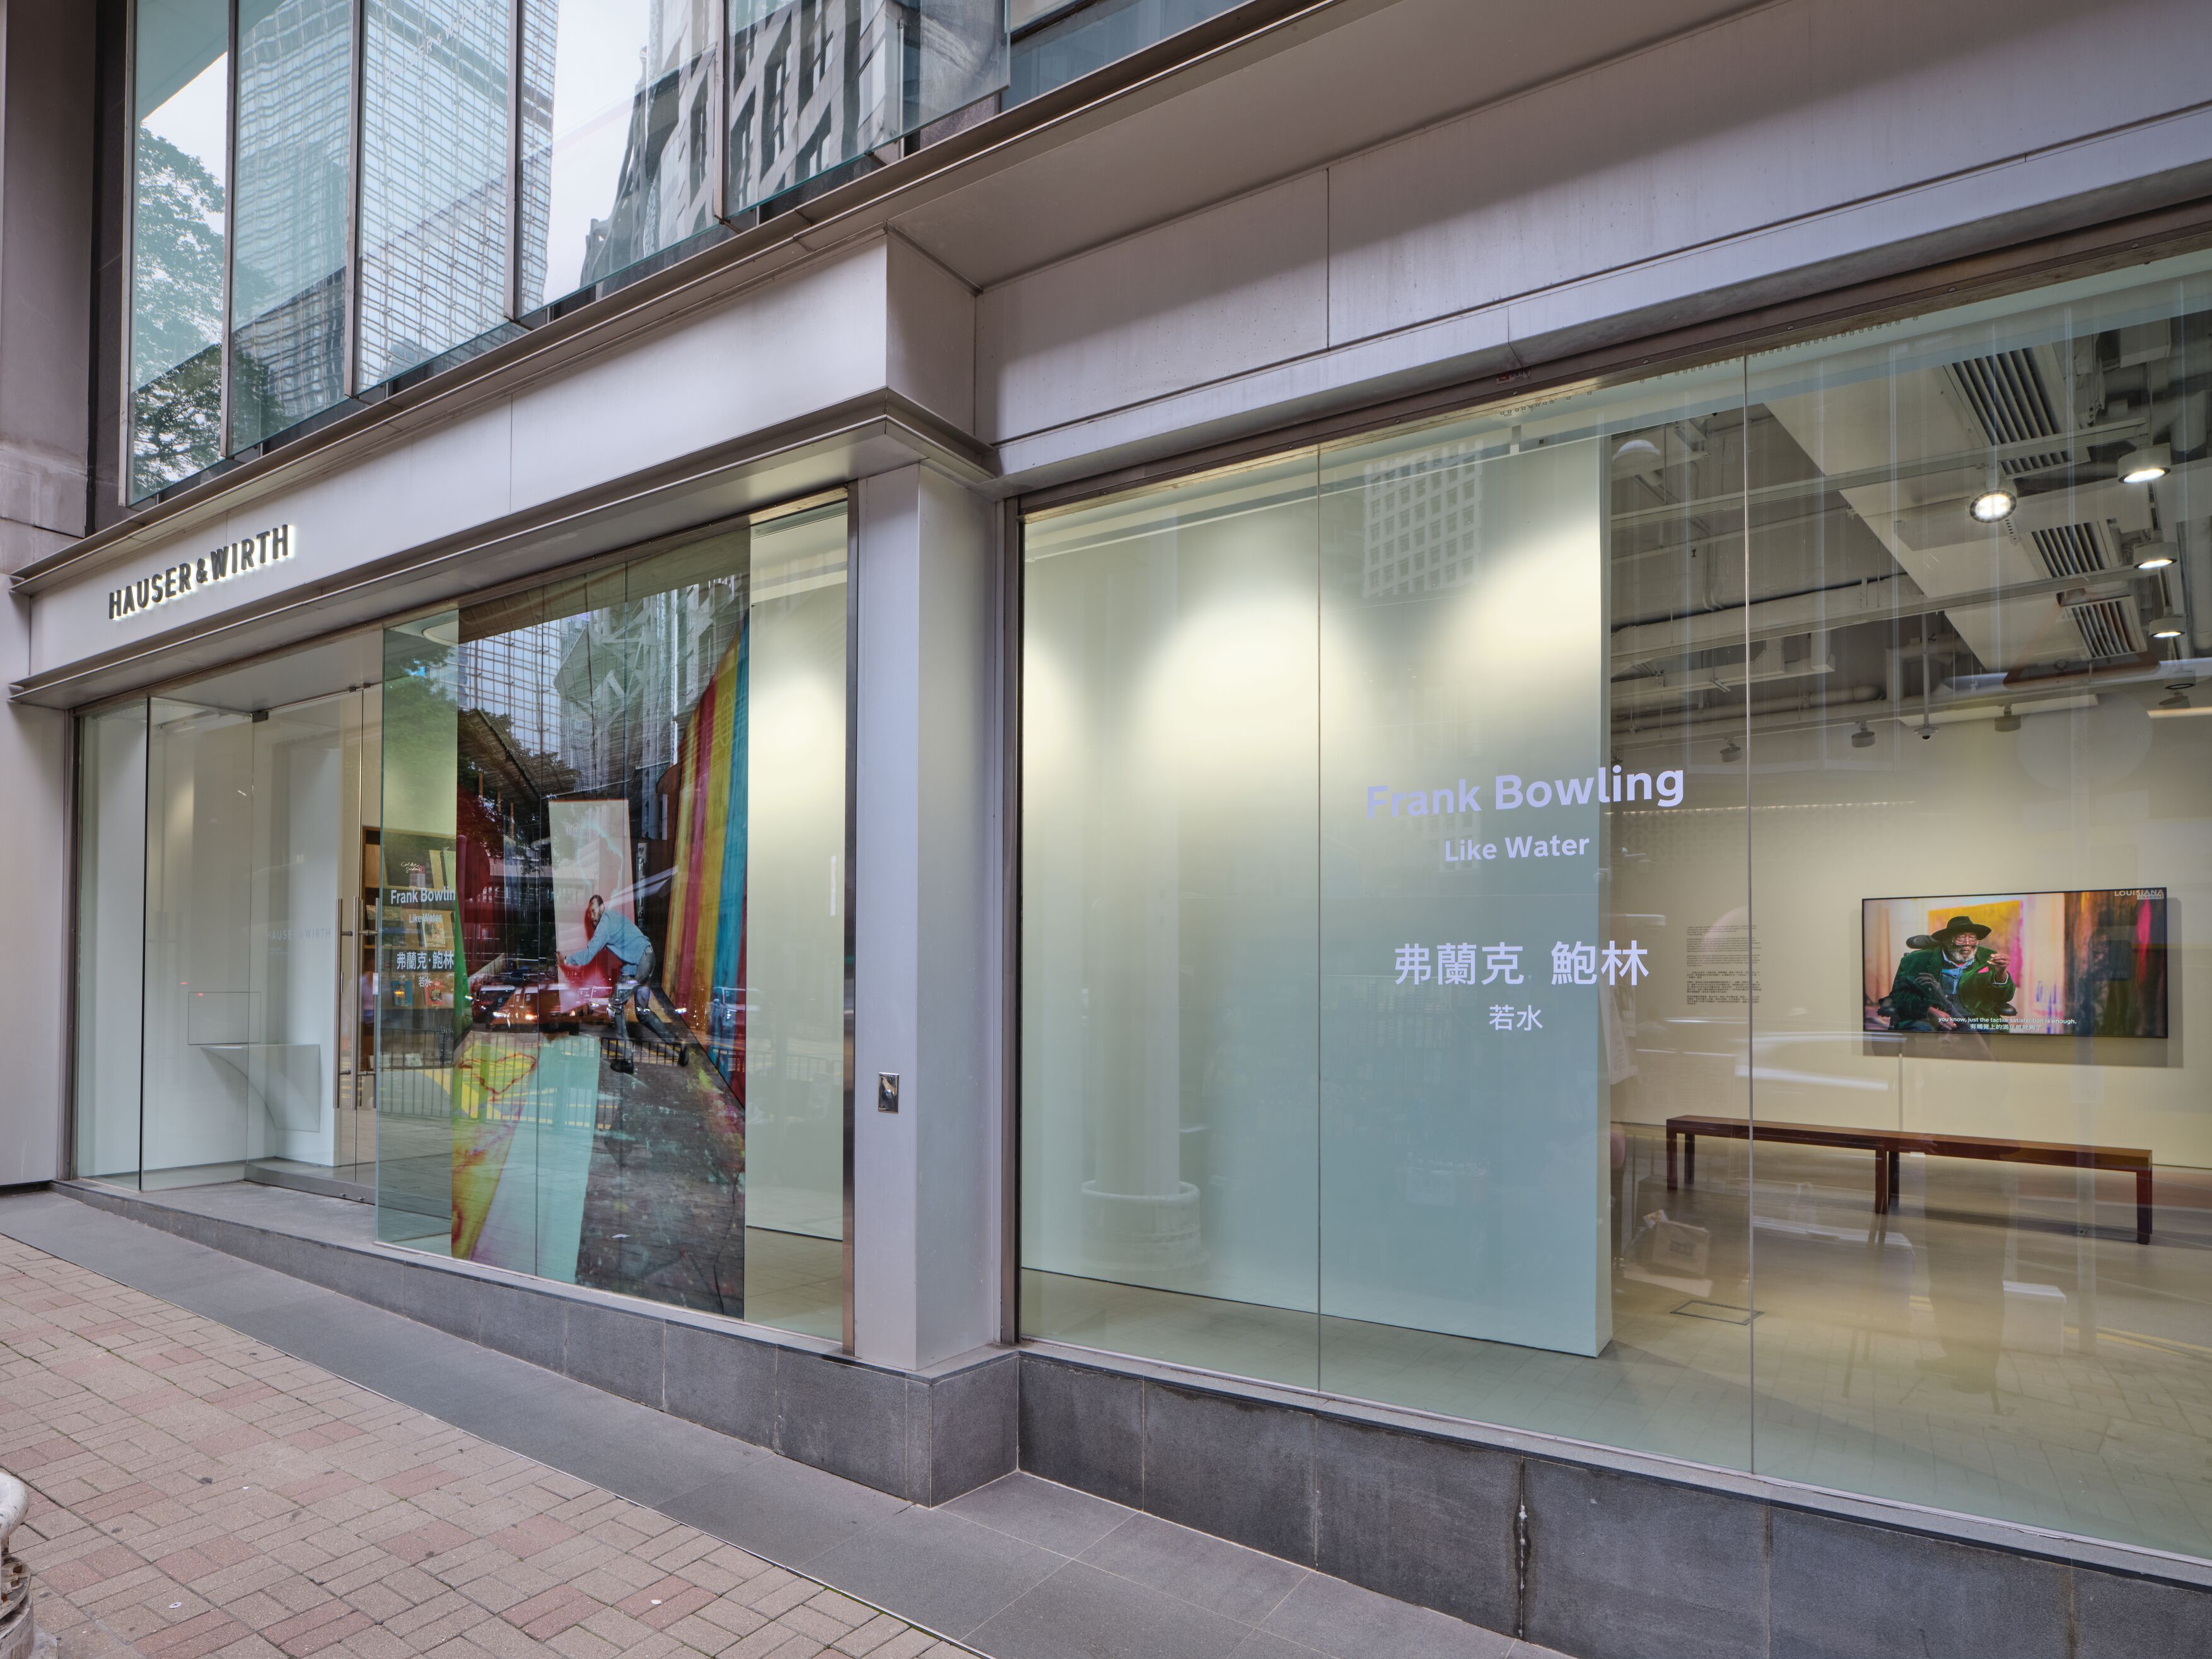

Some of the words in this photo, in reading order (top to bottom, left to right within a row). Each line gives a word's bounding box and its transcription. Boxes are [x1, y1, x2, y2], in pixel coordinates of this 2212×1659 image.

[109, 562, 191, 619] HAUSER
[196, 558, 208, 584] &
[210, 524, 288, 580] WIRTH
[1366, 779, 1482, 819] Frank
[1495, 765, 1684, 808] Bowling
[1445, 839, 1498, 861] Like
[1505, 834, 1590, 859] Water
[391, 888, 418, 904] Frank
[421, 885, 455, 902] Bowlin
[409, 914, 421, 924] Like
[422, 912, 443, 923] Water
[267, 928, 298, 940] HAUSE
[305, 928, 331, 939] WIRTH
[1394, 941, 1525, 986] 弗蘭克
[1551, 940, 1650, 986] 鮑林
[419, 975, 431, 987] 若水
[1489, 1004, 1544, 1031] 若水
